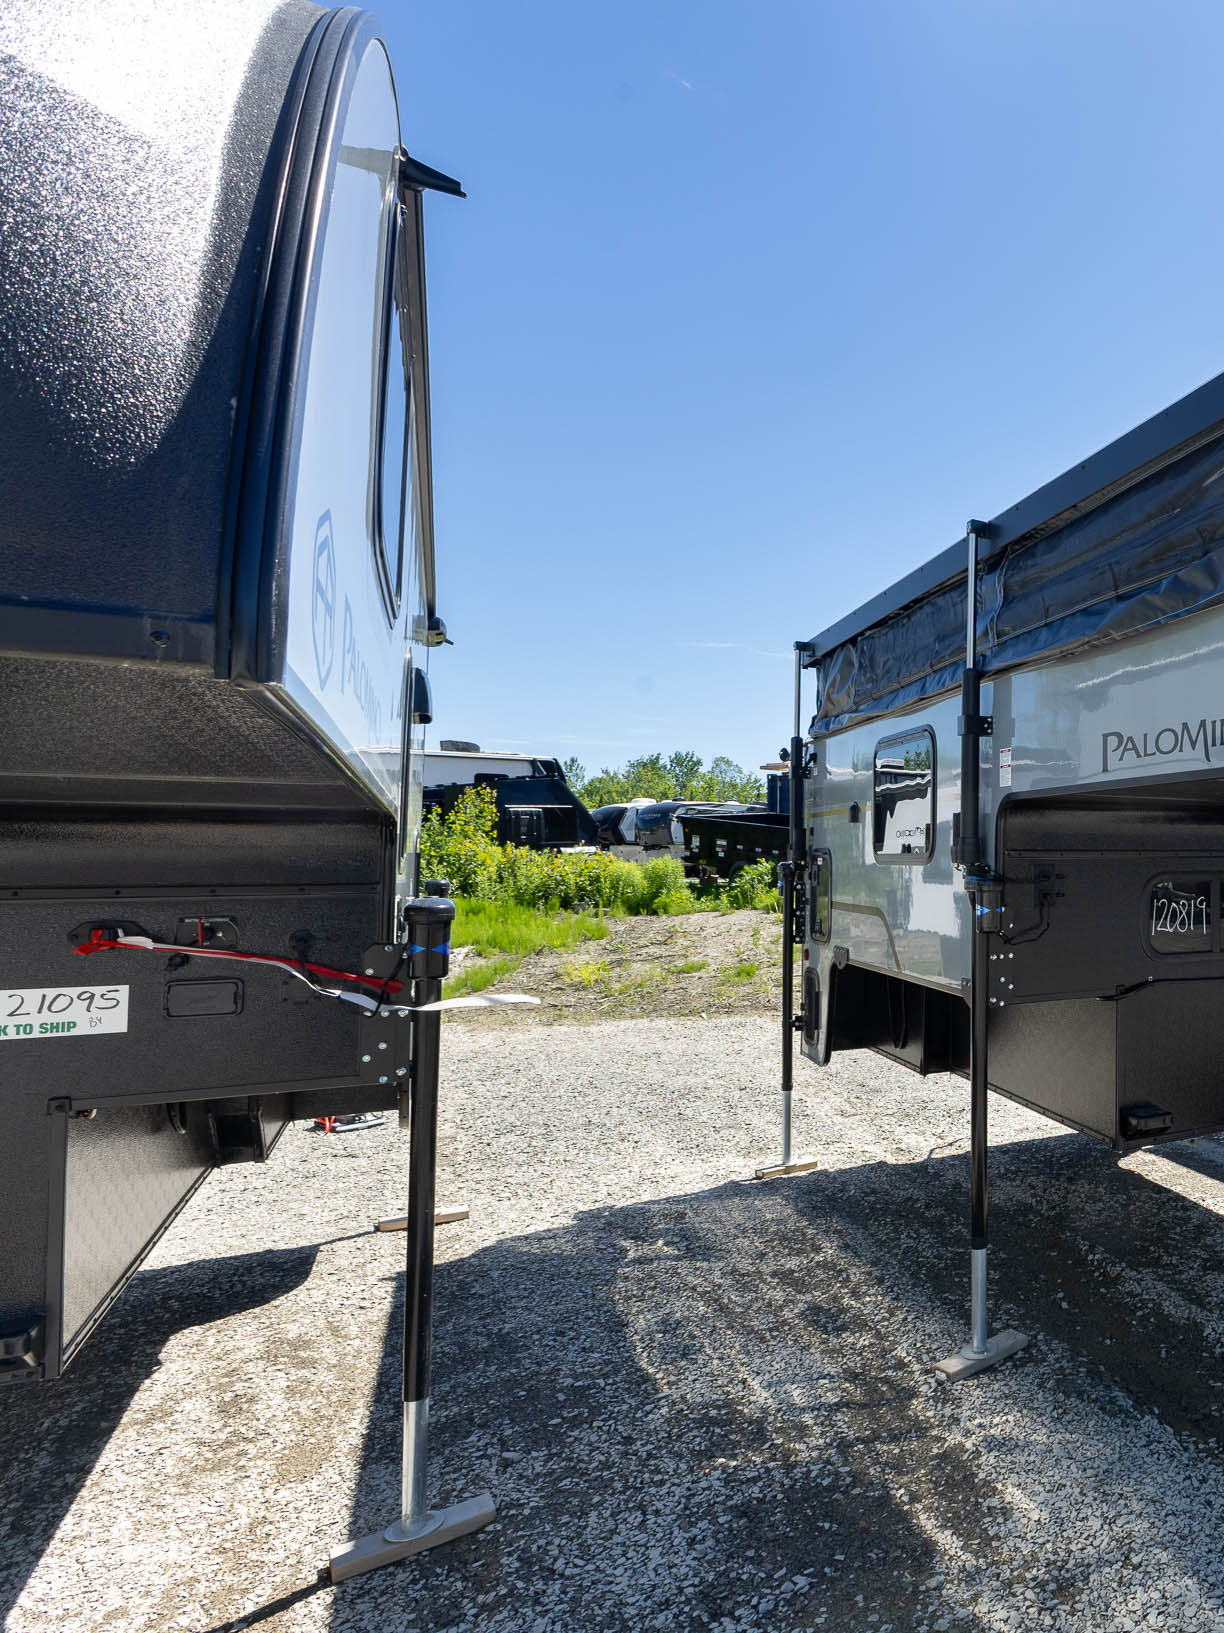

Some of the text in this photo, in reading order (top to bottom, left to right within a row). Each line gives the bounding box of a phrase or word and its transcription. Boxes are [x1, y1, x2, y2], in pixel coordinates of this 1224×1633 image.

[1151, 896, 1207, 936] 120819
[6, 989, 121, 1017] 21095
[13, 1023, 34, 1036] TO
[39, 1021, 77, 1034] SHIP
